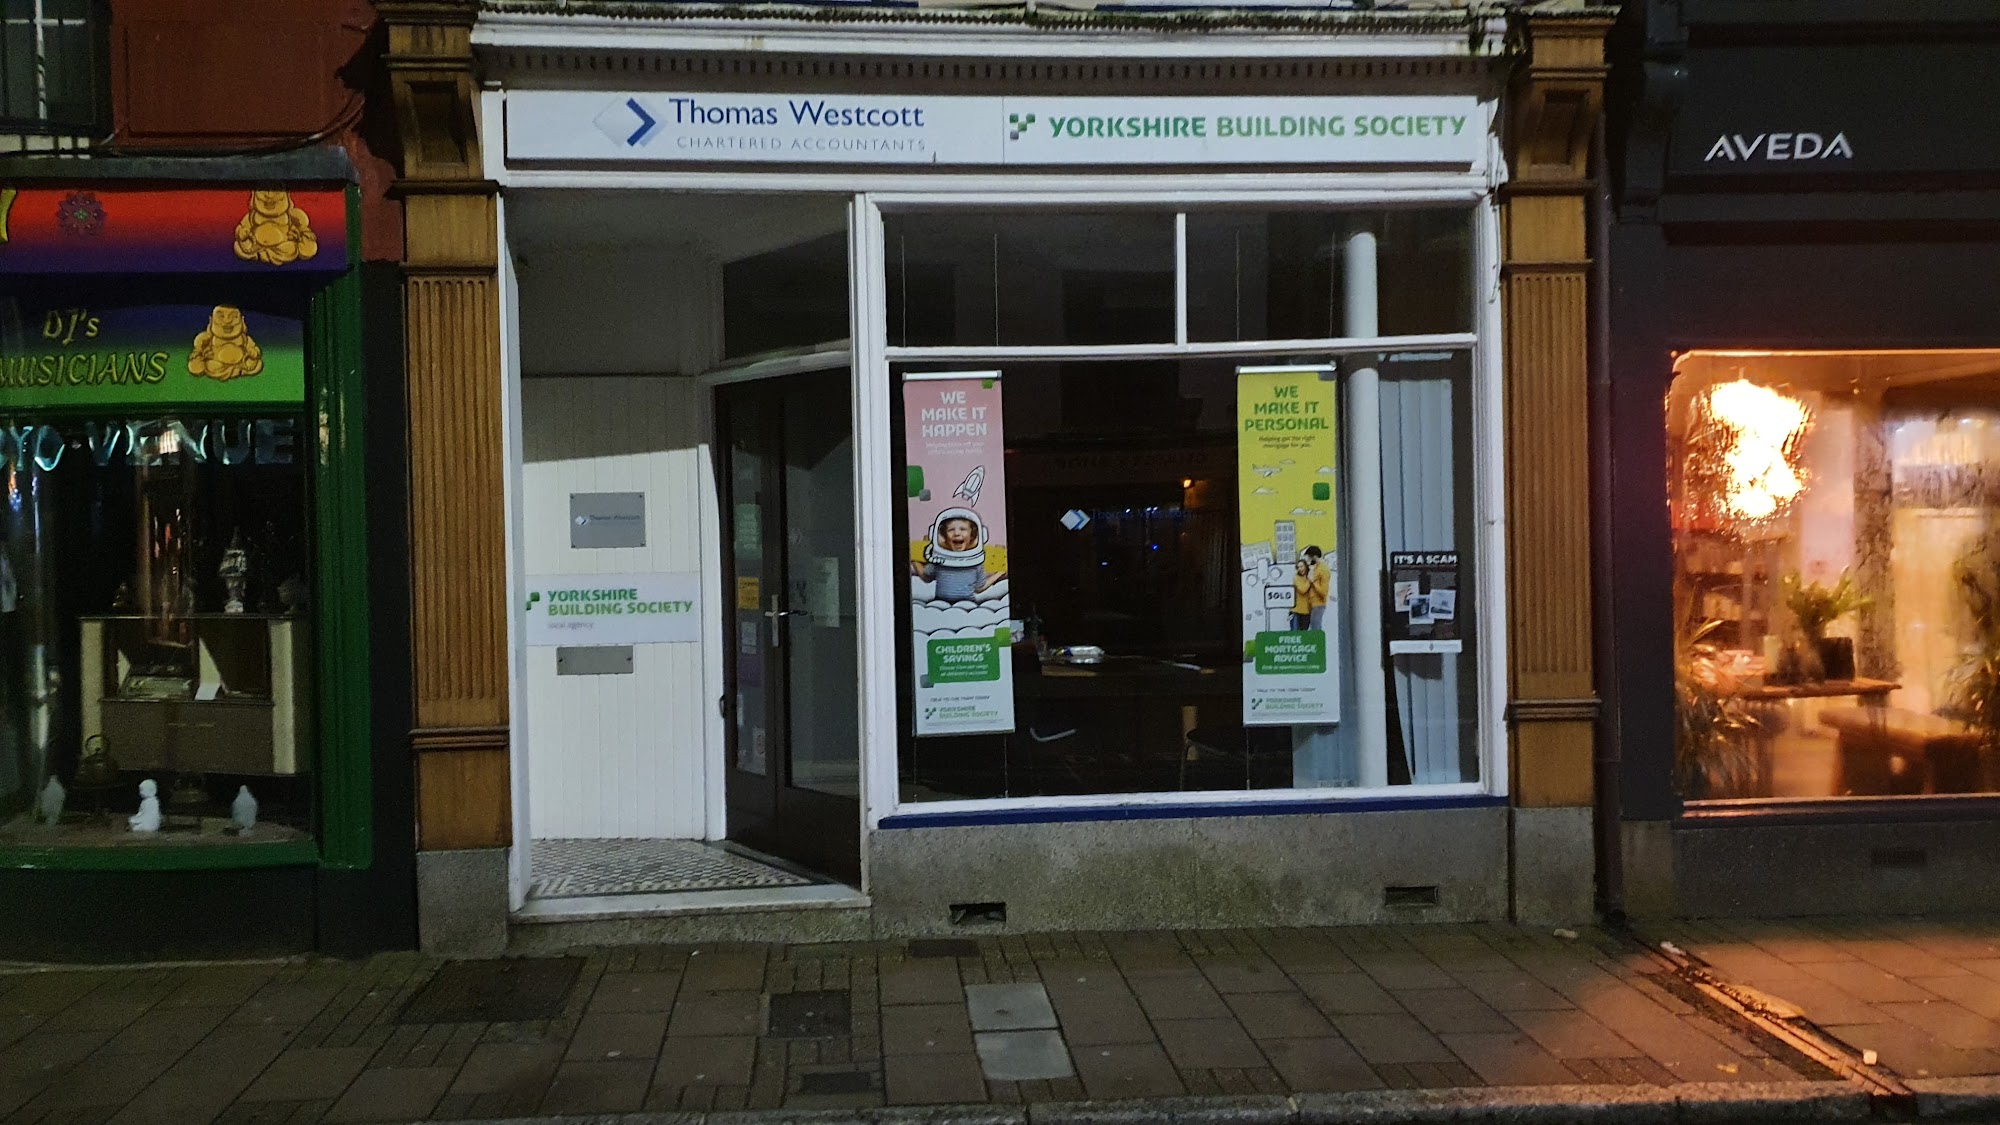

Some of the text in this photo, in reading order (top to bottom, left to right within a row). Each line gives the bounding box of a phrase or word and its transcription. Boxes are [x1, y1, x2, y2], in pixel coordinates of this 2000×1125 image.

[669, 98, 926, 127] Thomas Westcott
[1048, 114, 1467, 138] YORKSHIRE BUILDING SOCIETY
[676, 135, 926, 151] CHARTERED ACCOUNTANTS
[1704, 131, 1854, 162] AVEDA
[42, 308, 100, 346] DJ's
[940, 391, 967, 405] WE
[1273, 385, 1299, 399] WE
[921, 406, 987, 422] MAKE IT
[1254, 401, 1319, 415] MAKE IT
[922, 422, 988, 437] HAPPEN
[1244, 417, 1329, 432] PERSONAL
[1393, 553, 1458, 565] IT'S A SCAM
[547, 588, 638, 602] YORKSHIRE
[1267, 591, 1292, 600] SOLD
[548, 600, 693, 616] BUILDING SOCIETY
[1278, 635, 1302, 645] FREE
[935, 643, 992, 655] CHILDREN'S
[1264, 644, 1318, 654] MORTGAGE
[943, 652, 985, 664] SAVINGS
[1273, 653, 1308, 663] ADVICE
